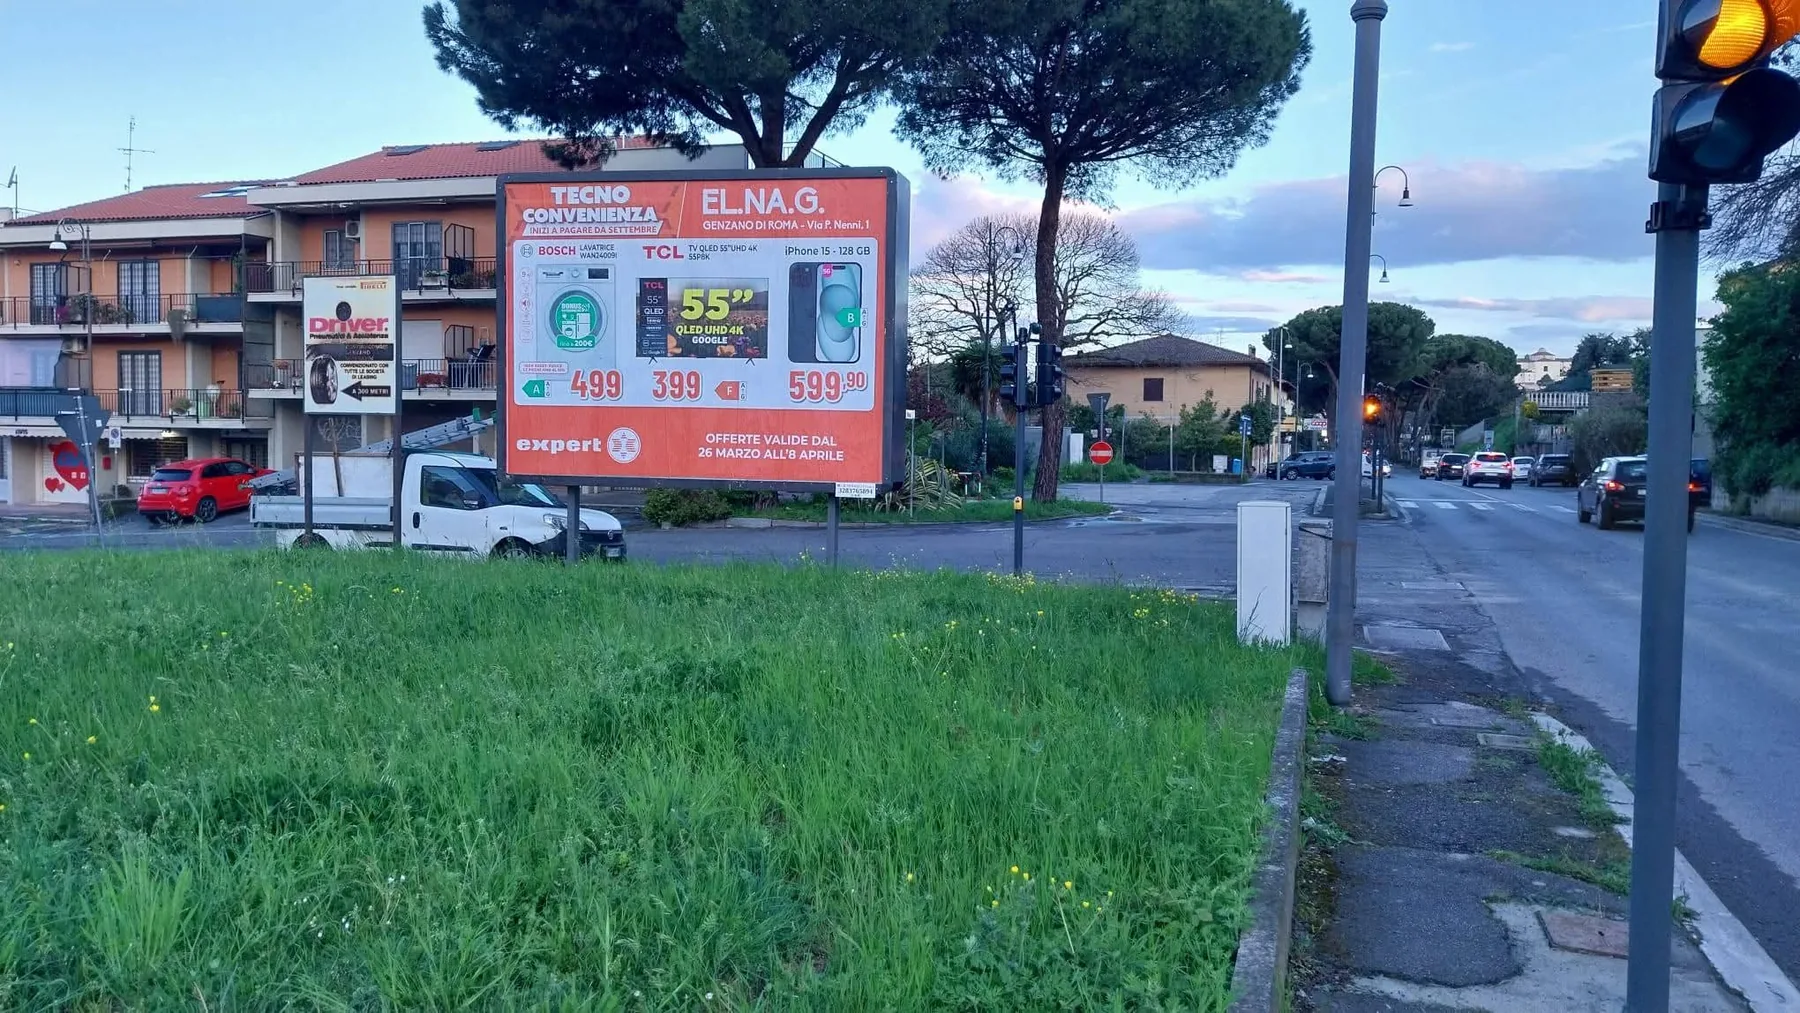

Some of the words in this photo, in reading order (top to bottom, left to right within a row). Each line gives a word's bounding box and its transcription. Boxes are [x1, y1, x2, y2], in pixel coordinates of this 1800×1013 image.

[551, 185, 631, 205] TECNO
[702, 186, 825, 215] EL.NA.G.
[522, 206, 659, 224] CONVENIENZA
[529, 226, 550, 234] INIZI
[551, 226, 558, 234] A
[559, 226, 594, 234] PAGARE
[594, 226, 608, 234] DA
[608, 226, 657, 234] SETTEMBRE
[702, 220, 754, 231] GENZANO
[755, 221, 767, 230] DI
[768, 220, 799, 230] ROMA
[806, 219, 823, 230] Via
[824, 220, 833, 230] P.
[865, 219, 870, 230] 1
[538, 245, 576, 256] BOSCH
[579, 243, 615, 251] LAVATRICE
[642, 245, 684, 260] TCL
[688, 244, 698, 252] TV
[699, 244, 719, 252] QLED
[747, 244, 758, 252] 4K
[784, 245, 819, 256] iPhone
[820, 246, 831, 256] 15
[838, 246, 854, 256] 128
[856, 246, 871, 256] GB
[643, 281, 665, 290] TCL
[643, 307, 664, 316] QLED
[847, 312, 855, 323] B
[675, 325, 704, 336] QLED
[704, 325, 728, 335] UHD
[728, 325, 745, 335] 4K
[574, 339, 593, 347] 200€
[691, 336, 728, 344] GOOGLE
[533, 384, 540, 394] A
[570, 369, 622, 399] 499
[651, 370, 702, 400] 399
[726, 386, 732, 396] F
[705, 433, 761, 445] OFFERTE
[763, 434, 809, 446] VALIDE
[811, 435, 838, 447] DAL
[515, 437, 602, 455] expert
[698, 447, 713, 458] 26
[715, 448, 761, 459] MARZO
[763, 449, 796, 460] ALL'8
[799, 450, 844, 461] APRILE
